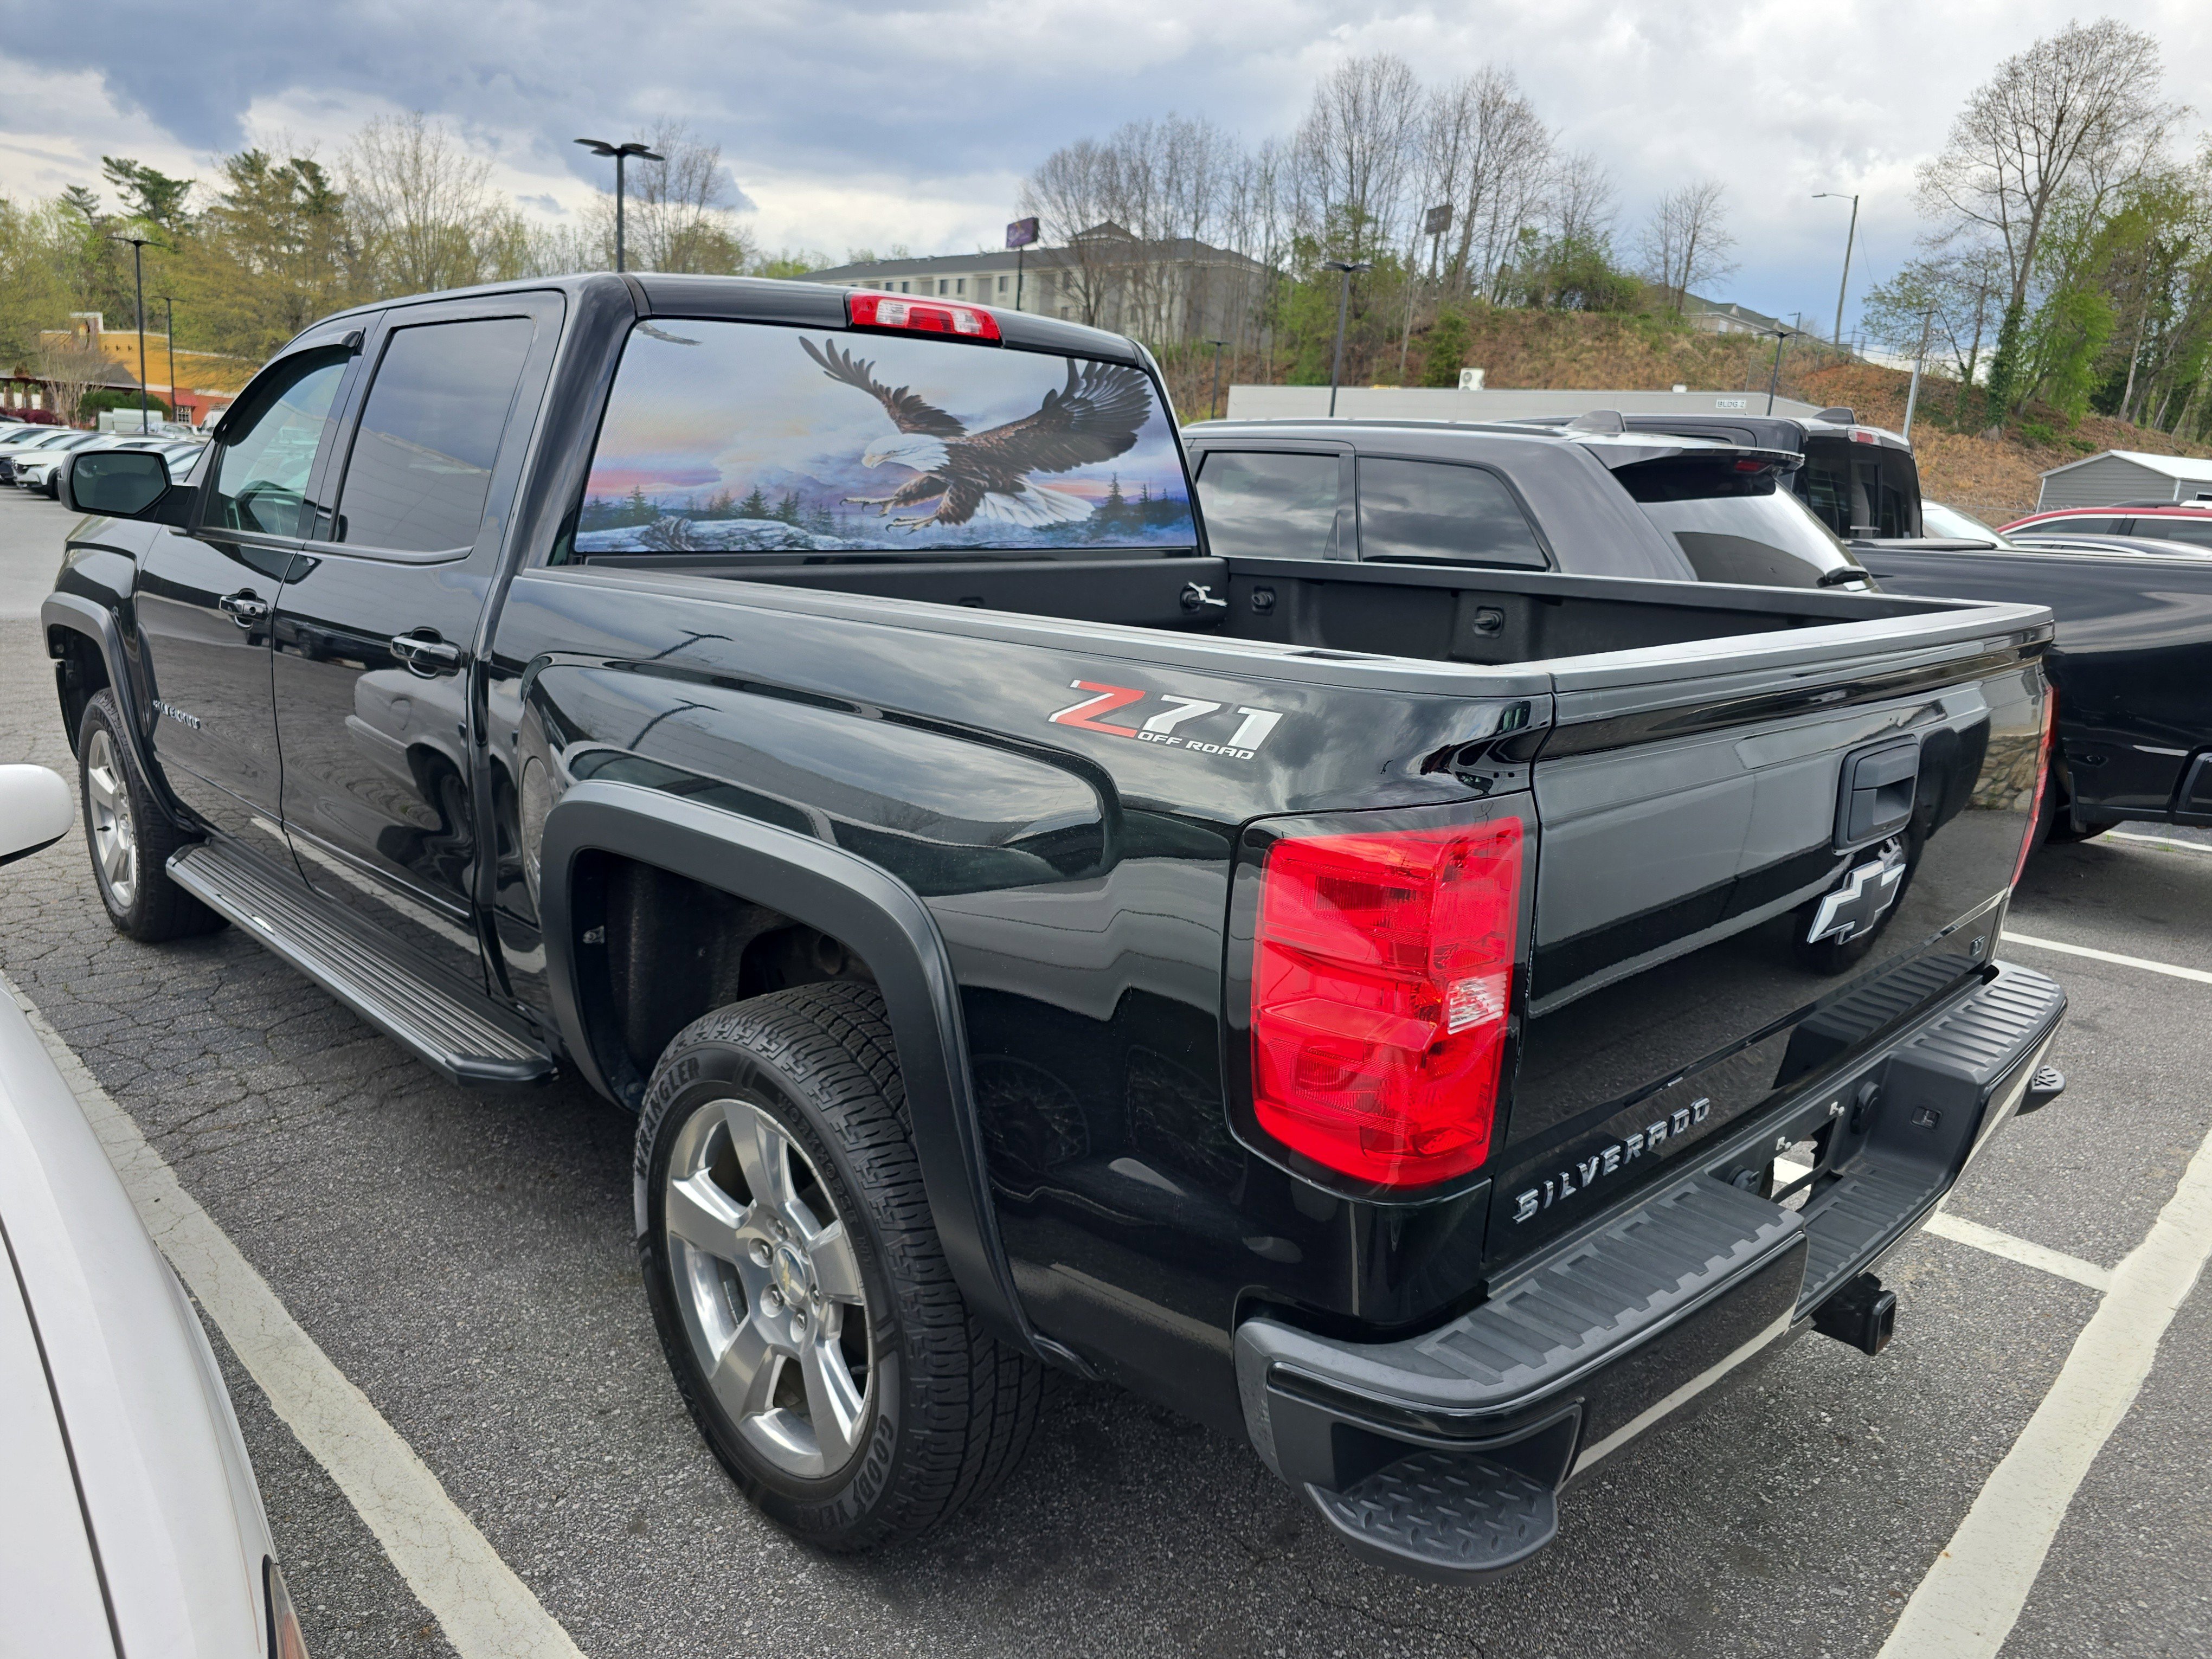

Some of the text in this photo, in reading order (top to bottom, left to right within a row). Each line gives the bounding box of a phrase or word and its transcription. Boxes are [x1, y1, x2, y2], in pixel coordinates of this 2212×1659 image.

[1047, 679, 1284, 750] Z71
[1137, 731, 1255, 760] OFF ROAD
[635, 1057, 701, 1180] WRANGLER
[776, 1091, 859, 1223] WORKHORSE
[1512, 1096, 1710, 1224] SILVERADO
[794, 1413, 894, 1532] GOODYE
